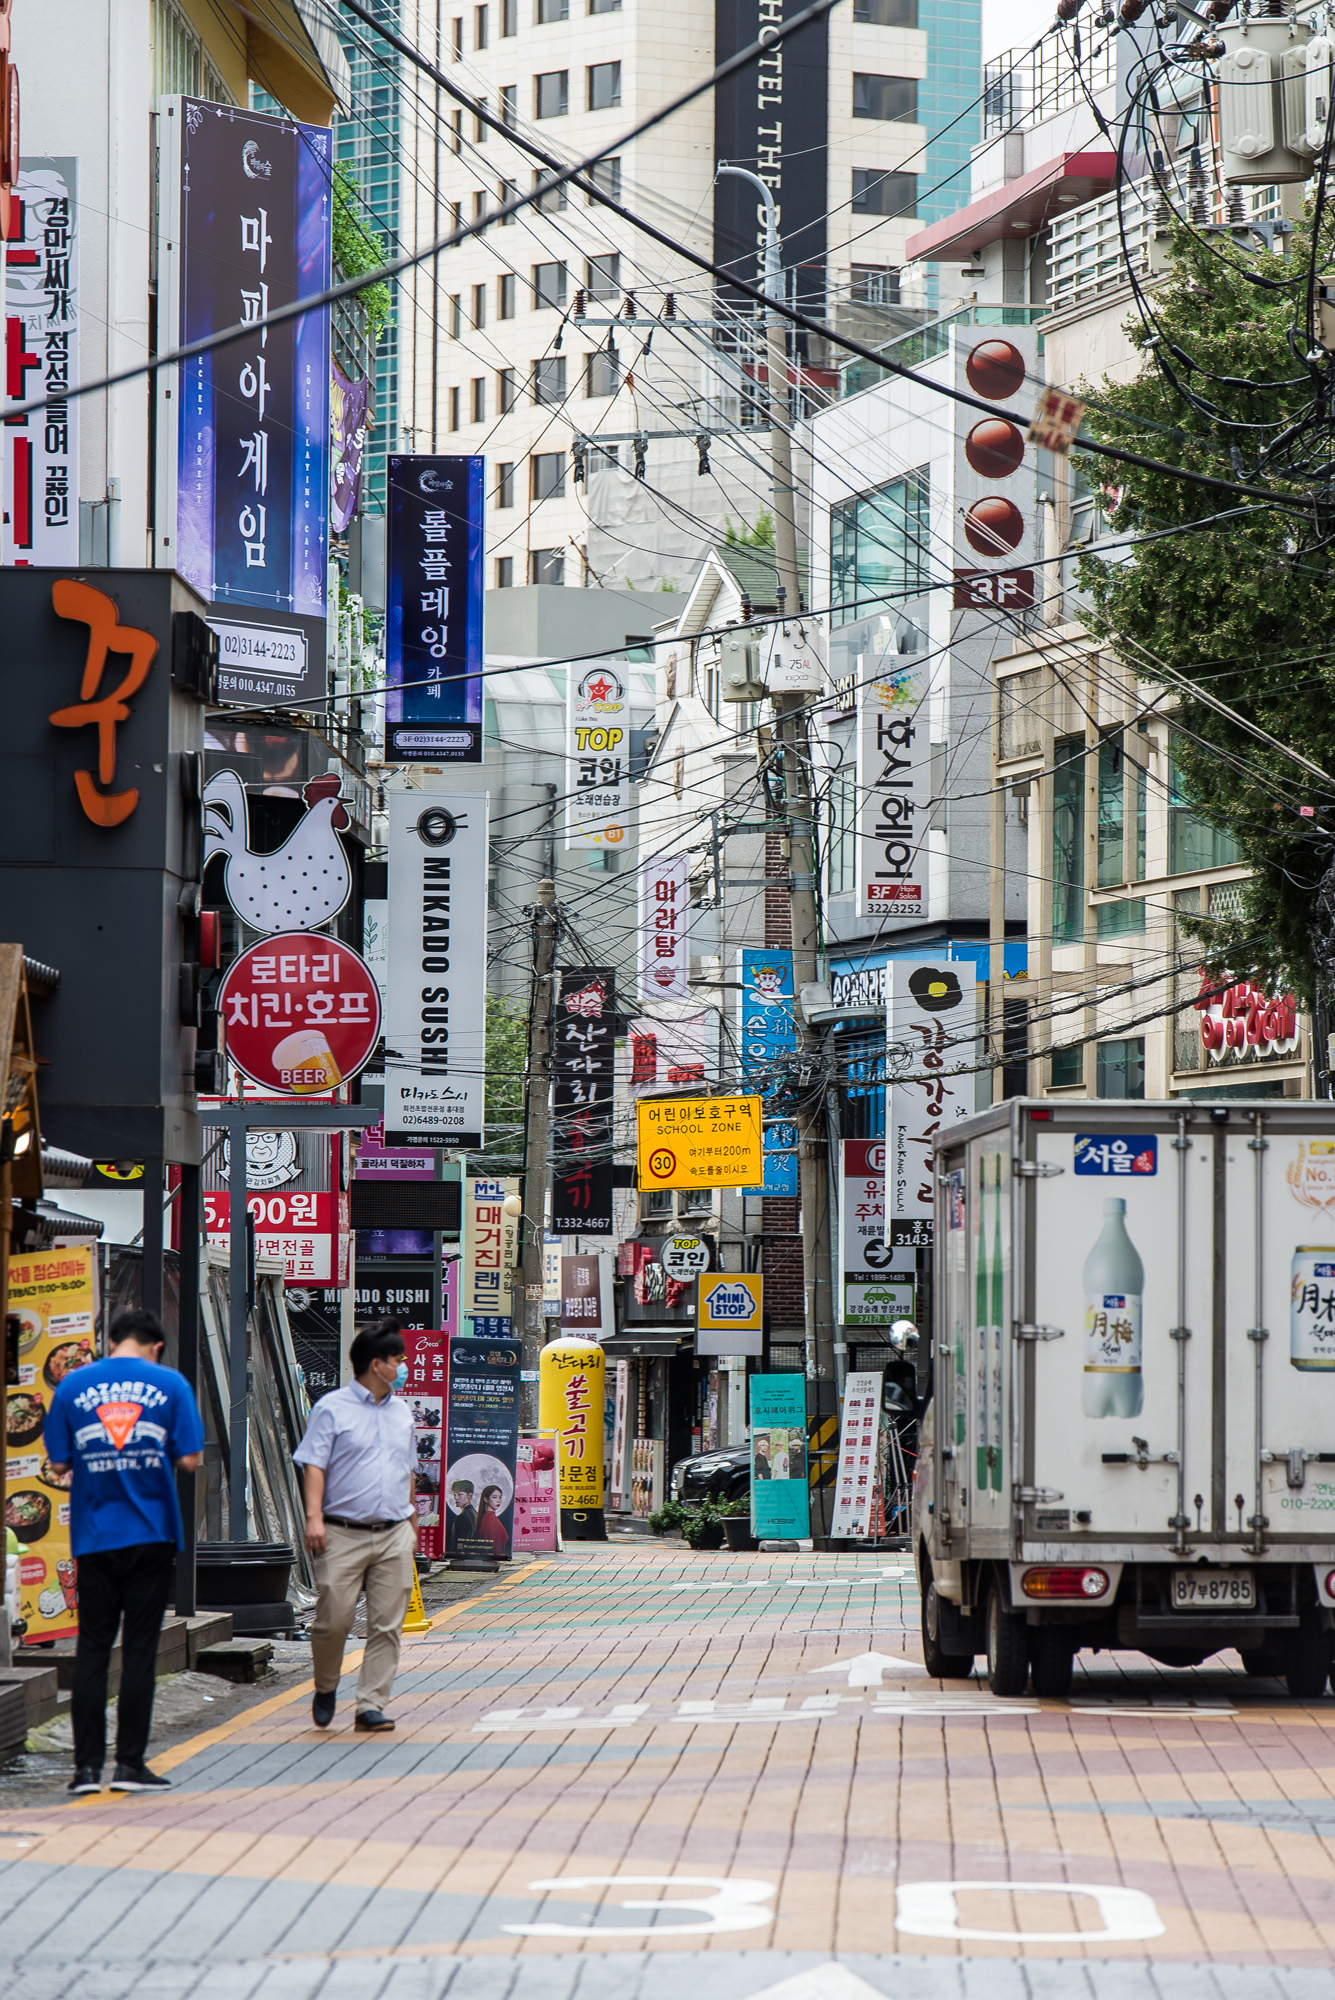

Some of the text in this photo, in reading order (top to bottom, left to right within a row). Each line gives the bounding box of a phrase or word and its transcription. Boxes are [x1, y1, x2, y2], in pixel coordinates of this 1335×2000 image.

[756, 121, 783, 190] THE
[238, 206, 273, 569] 마피아게임
[418, 509, 453, 659] 롤플레잉
[969, 577, 1018, 603] 3F
[224, 635, 296, 661] 02)3144-2223
[238, 678, 296, 697] 010.4347.0155
[575, 728, 624, 751] TOP
[576, 757, 622, 787] 코인
[871, 885, 891, 899] 3F
[421, 857, 451, 975] MIKADO
[654, 880, 678, 958] 마라탕
[251, 953, 341, 984] 로타리
[565, 1022, 608, 1103] 잔다리
[280, 1067, 327, 1084] BEER
[402, 1115, 465, 1126] 02)6489-0208
[656, 1122, 742, 1135] SCHOOL ZONE
[653, 1156, 672, 1170] 30
[1081, 1139, 1136, 1173] 서울
[863, 1180, 886, 1199] 유
[203, 1193, 318, 1228] 5,00원
[555, 1217, 611, 1229] T.332-4667
[673, 1240, 700, 1249] TOP
[473, 1206, 502, 1312] 매거진랜드
[667, 1251, 705, 1266] 코인
[323, 1288, 430, 1304] MIADO SUSHI
[716, 1293, 745, 1304] MINI
[715, 1304, 747, 1315] STOP
[550, 1353, 601, 1370] 잔다리
[73, 1380, 168, 1409] NAZARETH
[562, 1374, 591, 1460] 불고기
[1176, 1580, 1251, 1600] 87부8785
